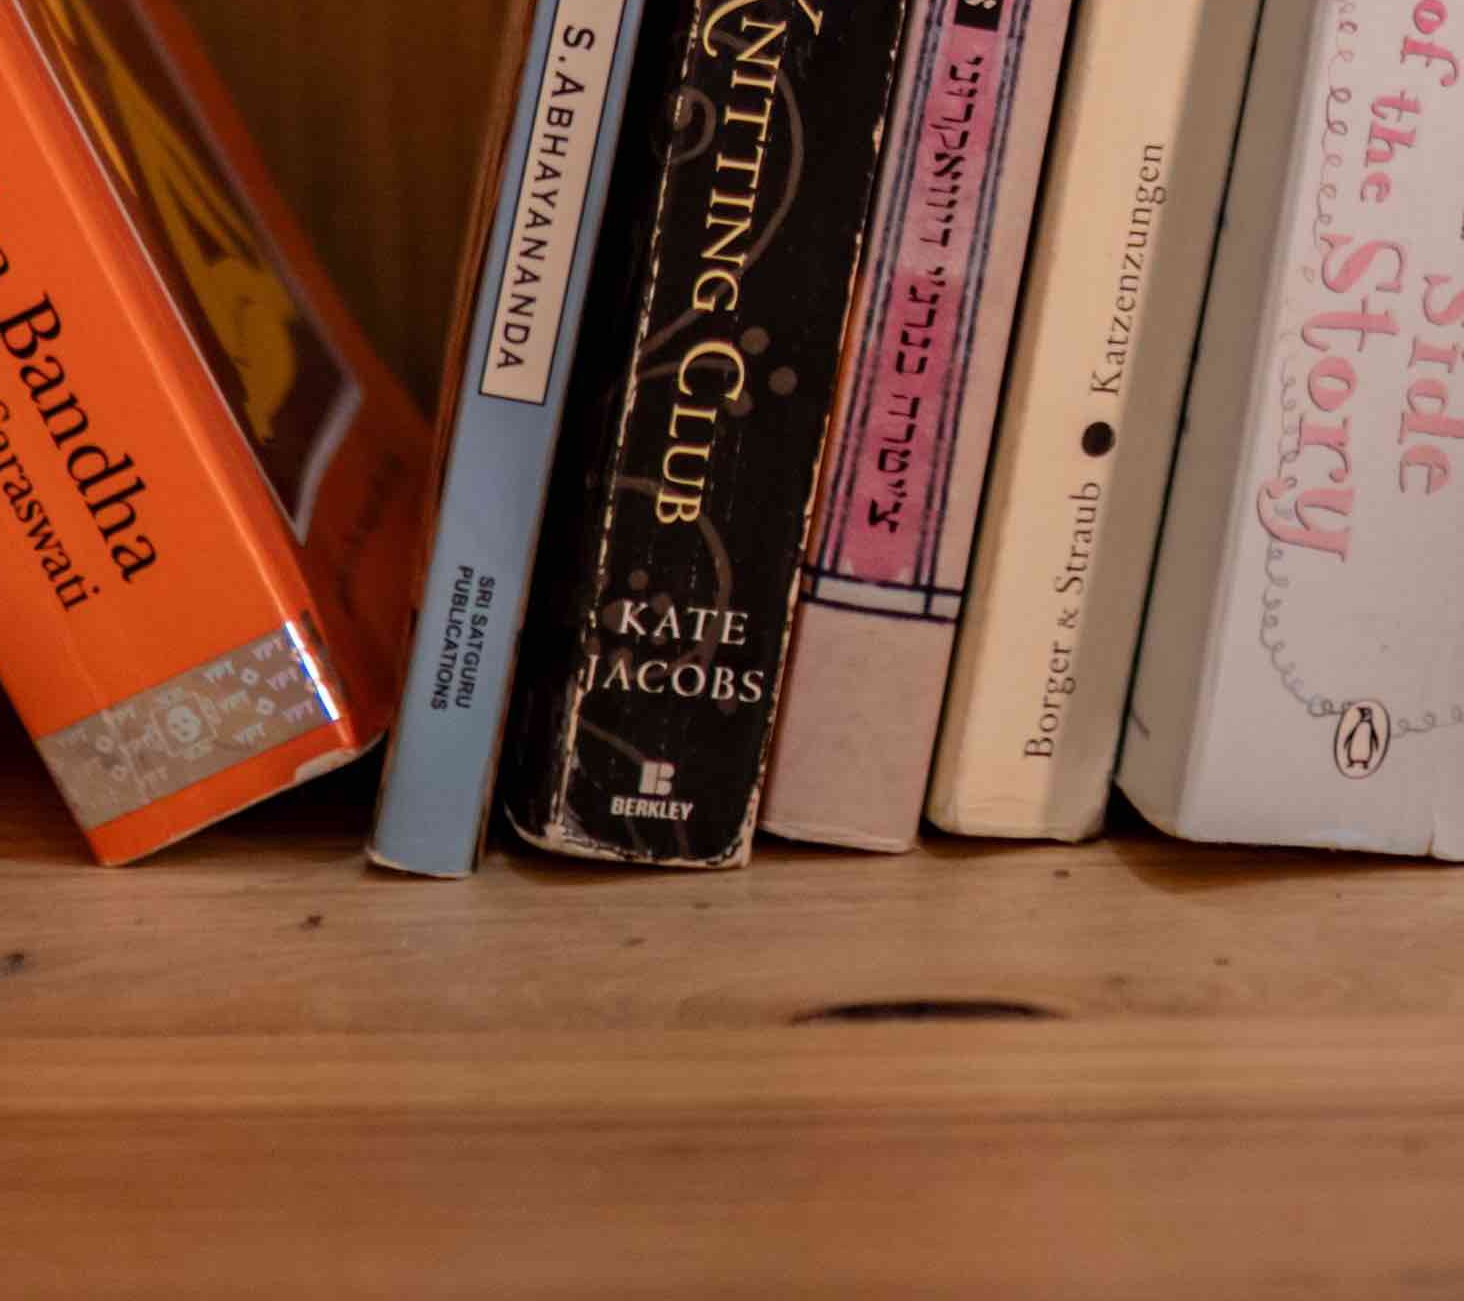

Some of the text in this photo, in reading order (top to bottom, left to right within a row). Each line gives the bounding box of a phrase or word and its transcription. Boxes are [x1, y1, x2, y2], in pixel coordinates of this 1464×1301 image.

[1359, 94, 1423, 205] the
[655, 341, 745, 526] CLUB
[1023, 141, 1167, 761] Borger & Straub Katzenzungen
[1256, 233, 1408, 563] Story
[430, 564, 474, 711] PUBLICATIONS
[455, 575, 496, 710] SRI SATGURU
[584, 653, 765, 704] JACOBS
[619, 599, 750, 646] KATE
[610, 795, 695, 821] BERKLEY
